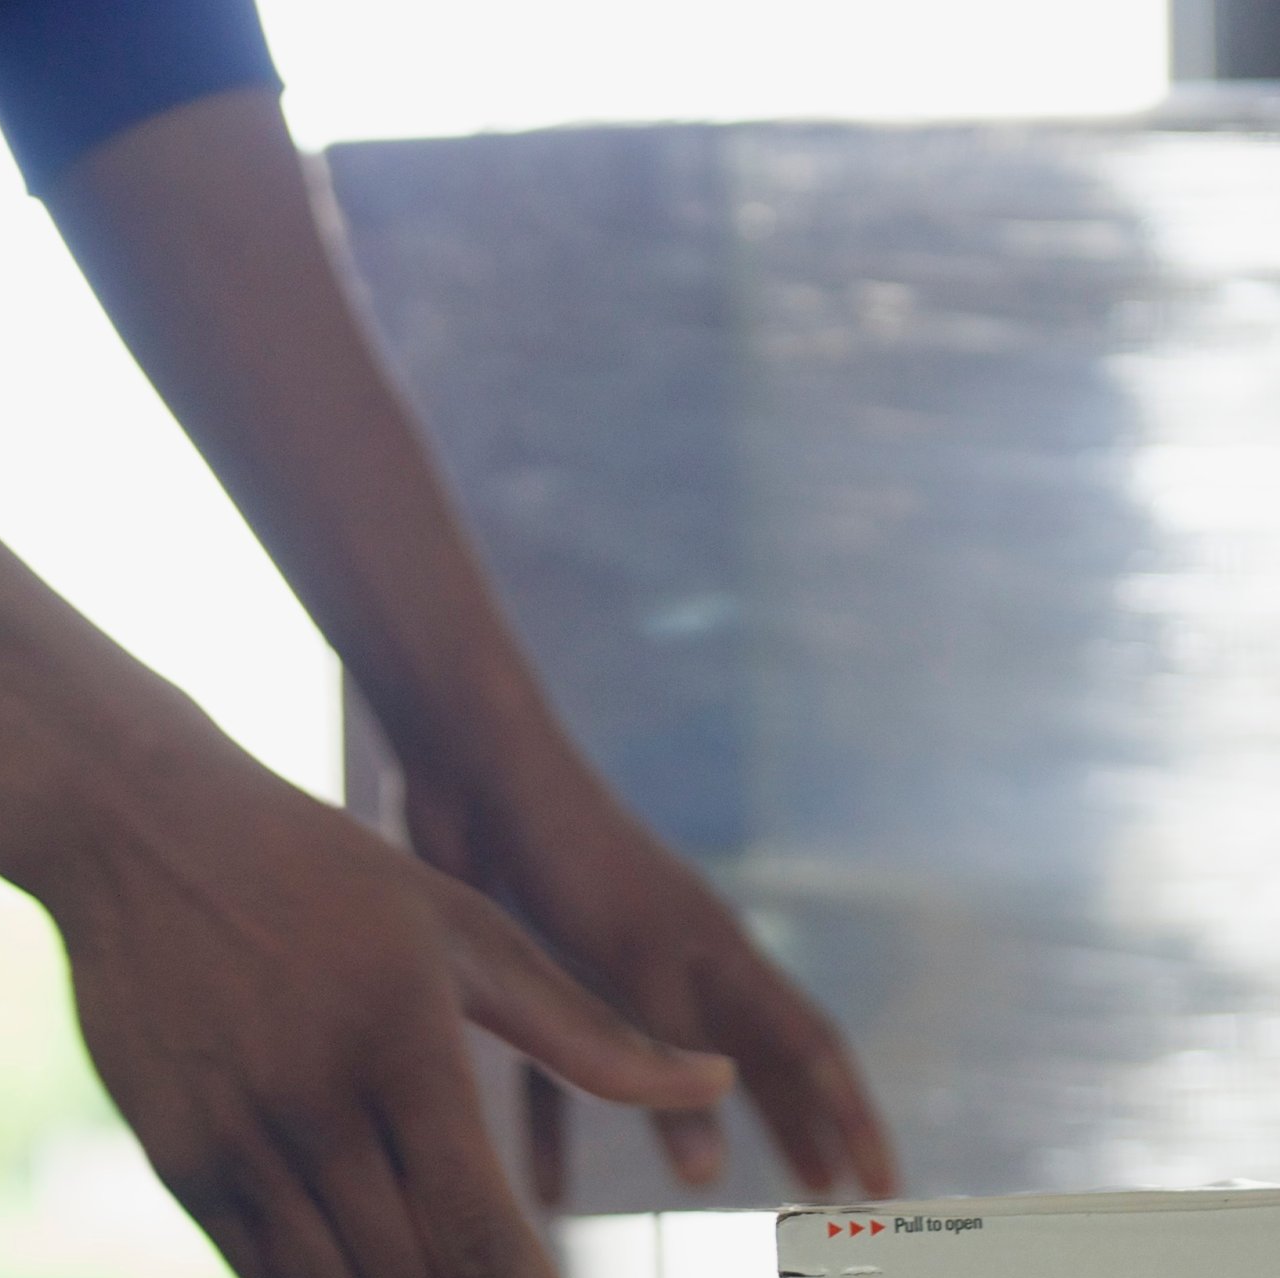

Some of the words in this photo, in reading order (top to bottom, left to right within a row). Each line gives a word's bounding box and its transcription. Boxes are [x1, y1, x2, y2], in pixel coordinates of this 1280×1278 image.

[894, 1216, 923, 1234] Pull
[926, 1218, 942, 1232] to
[945, 1217, 983, 1235] open
